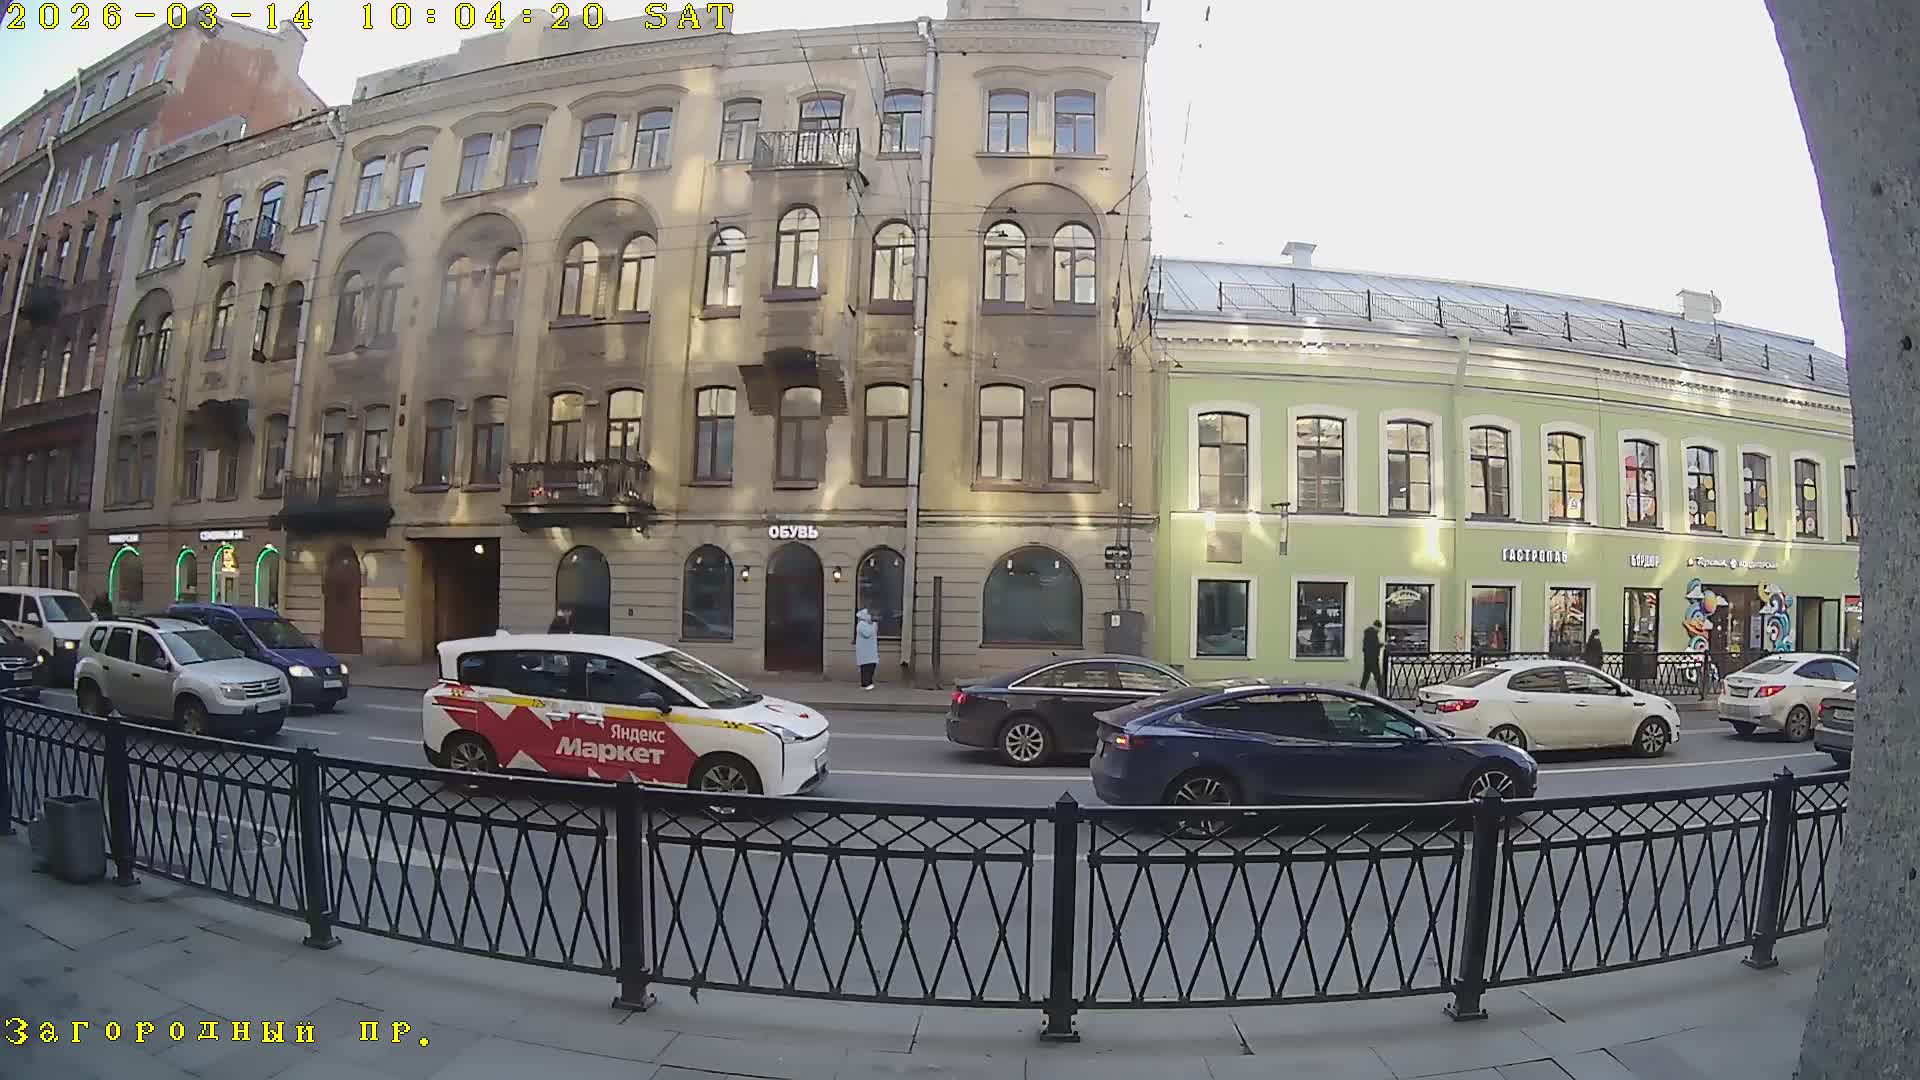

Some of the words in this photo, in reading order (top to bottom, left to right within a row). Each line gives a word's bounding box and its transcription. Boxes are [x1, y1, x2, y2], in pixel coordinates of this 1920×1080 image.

[768, 525, 819, 540] ОБУВЬ
[1502, 548, 1568, 564] ГАСТРОПАБ
[610, 723, 666, 744] Яндекс
[555, 735, 665, 765] Маркет
